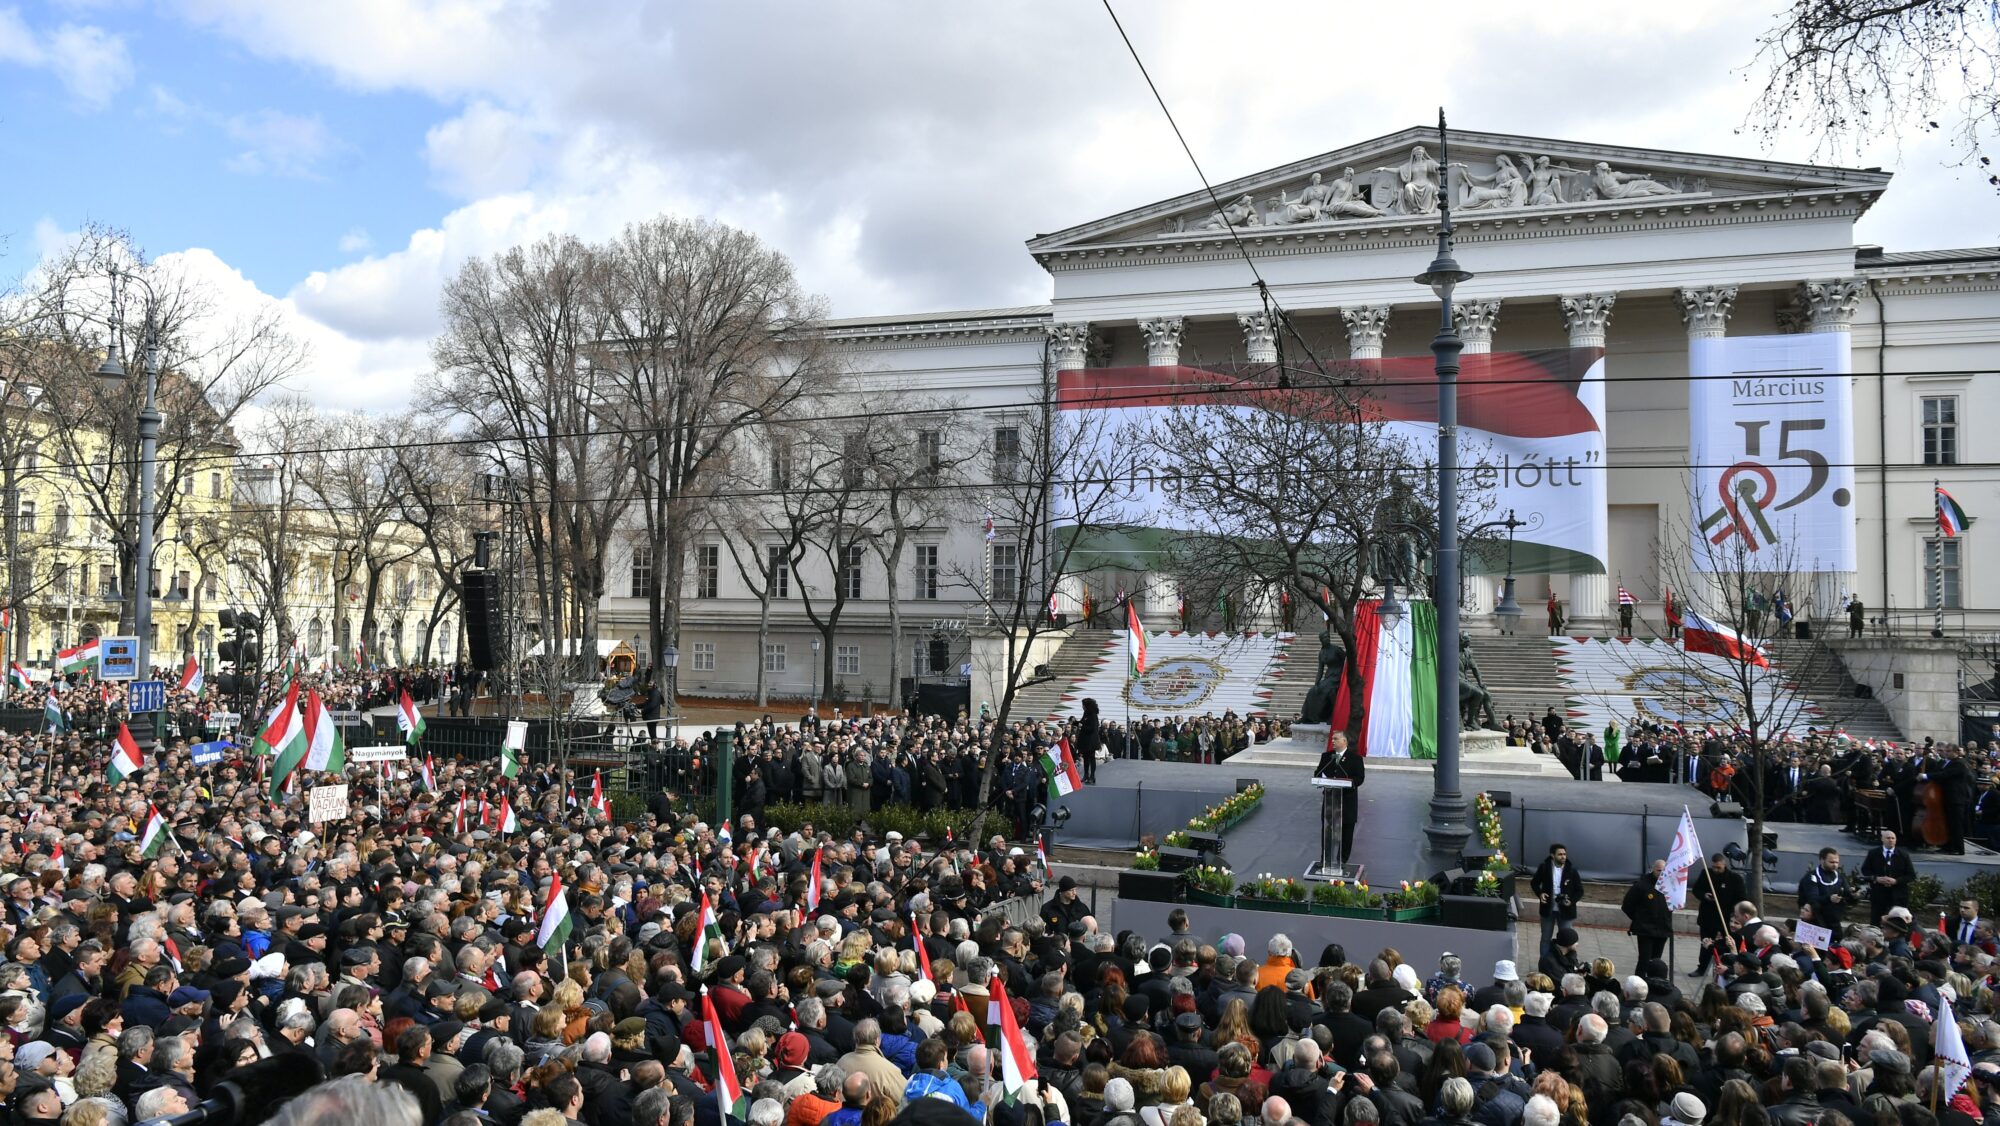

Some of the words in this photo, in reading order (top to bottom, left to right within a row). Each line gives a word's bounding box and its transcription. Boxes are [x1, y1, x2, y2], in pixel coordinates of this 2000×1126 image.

[1733, 379, 1825, 398] Március
[1473, 450, 1600, 489] előtt”
[1735, 419, 1851, 511] 15.
[240, 735, 251, 746] WC
[194, 751, 221, 763] SIÓFOK
[355, 748, 404, 758] Nagymányok
[312, 787, 337, 799] VELED
[312, 808, 342, 821] VIKTOR
